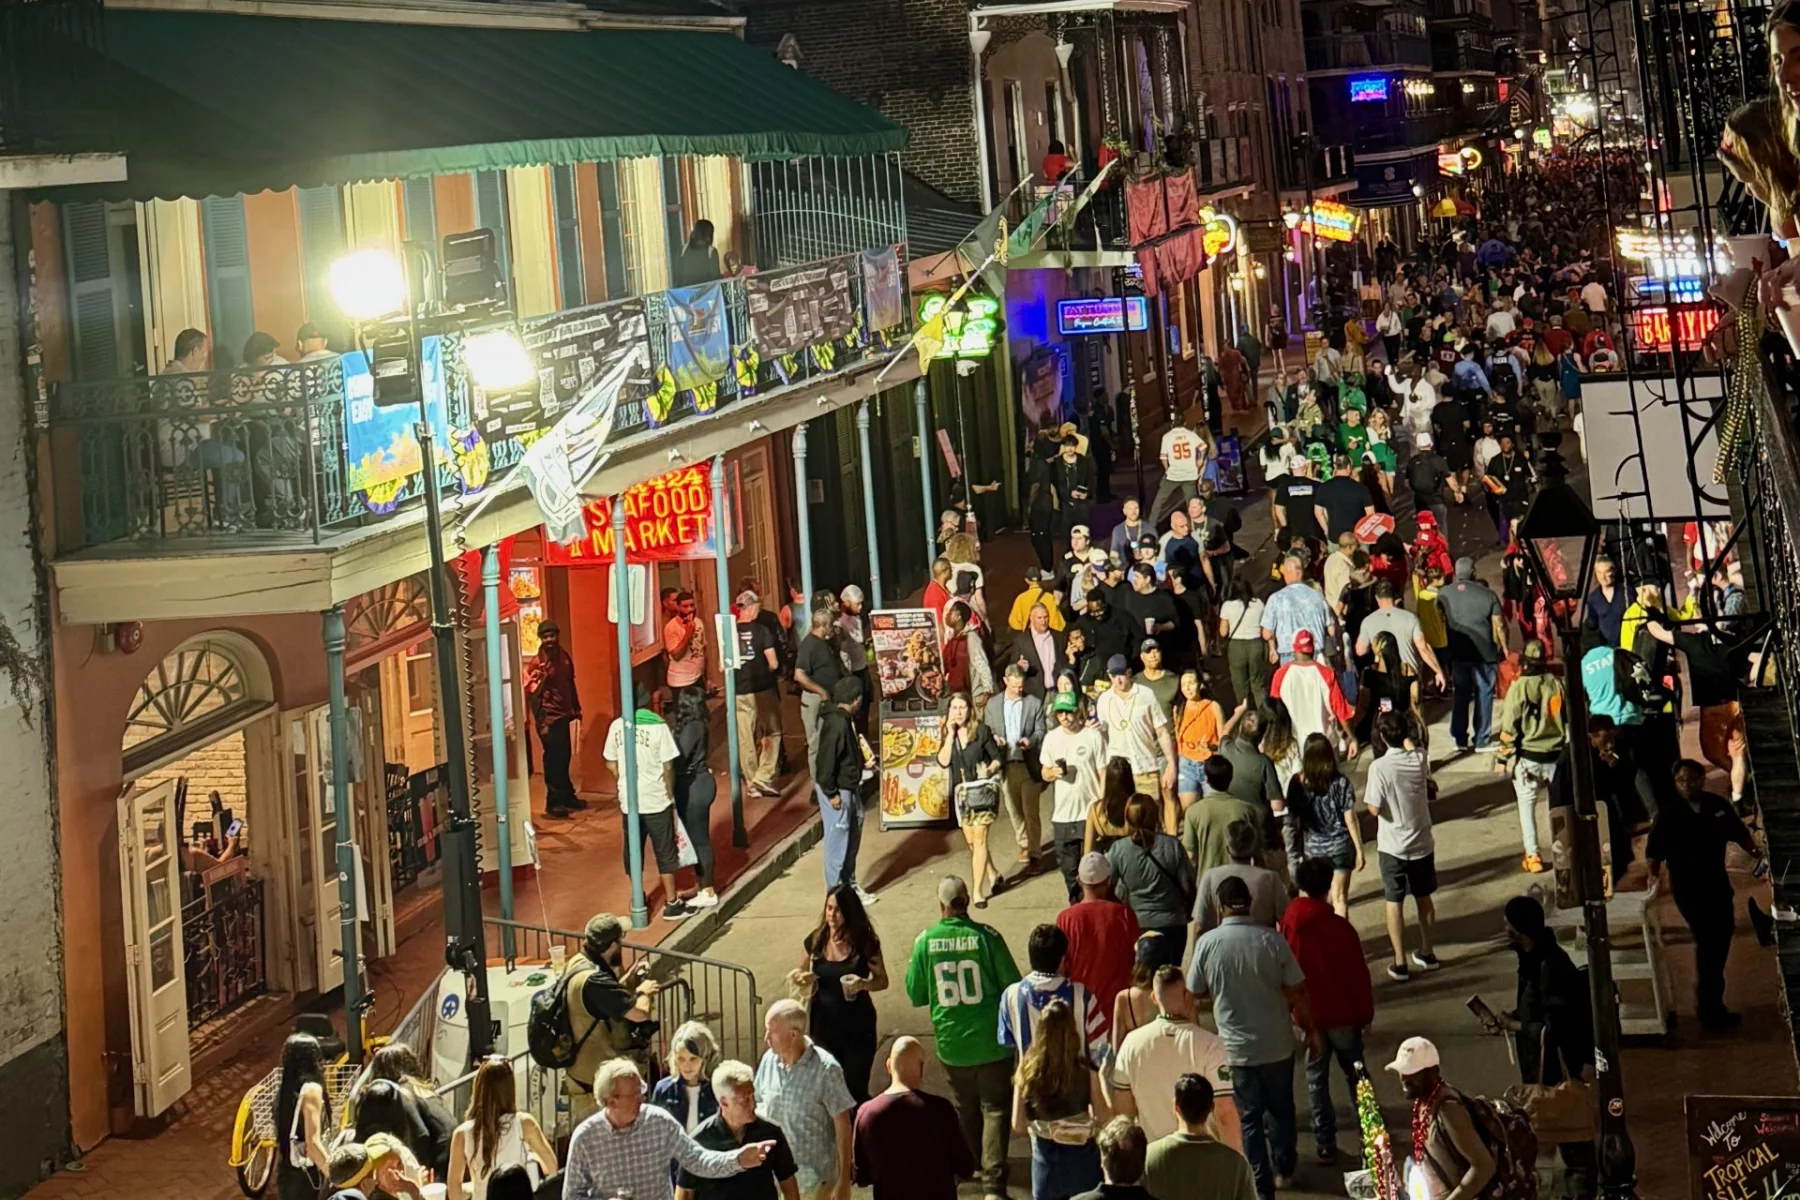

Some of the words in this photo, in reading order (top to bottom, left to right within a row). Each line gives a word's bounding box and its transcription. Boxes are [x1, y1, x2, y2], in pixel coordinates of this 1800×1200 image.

[1172, 441, 1192, 460] 95
[934, 960, 983, 1007] 60
[1700, 1110, 1747, 1147] Welcome
[1722, 1128, 1742, 1152] To
[1703, 1142, 1780, 1191] TROPICAL
